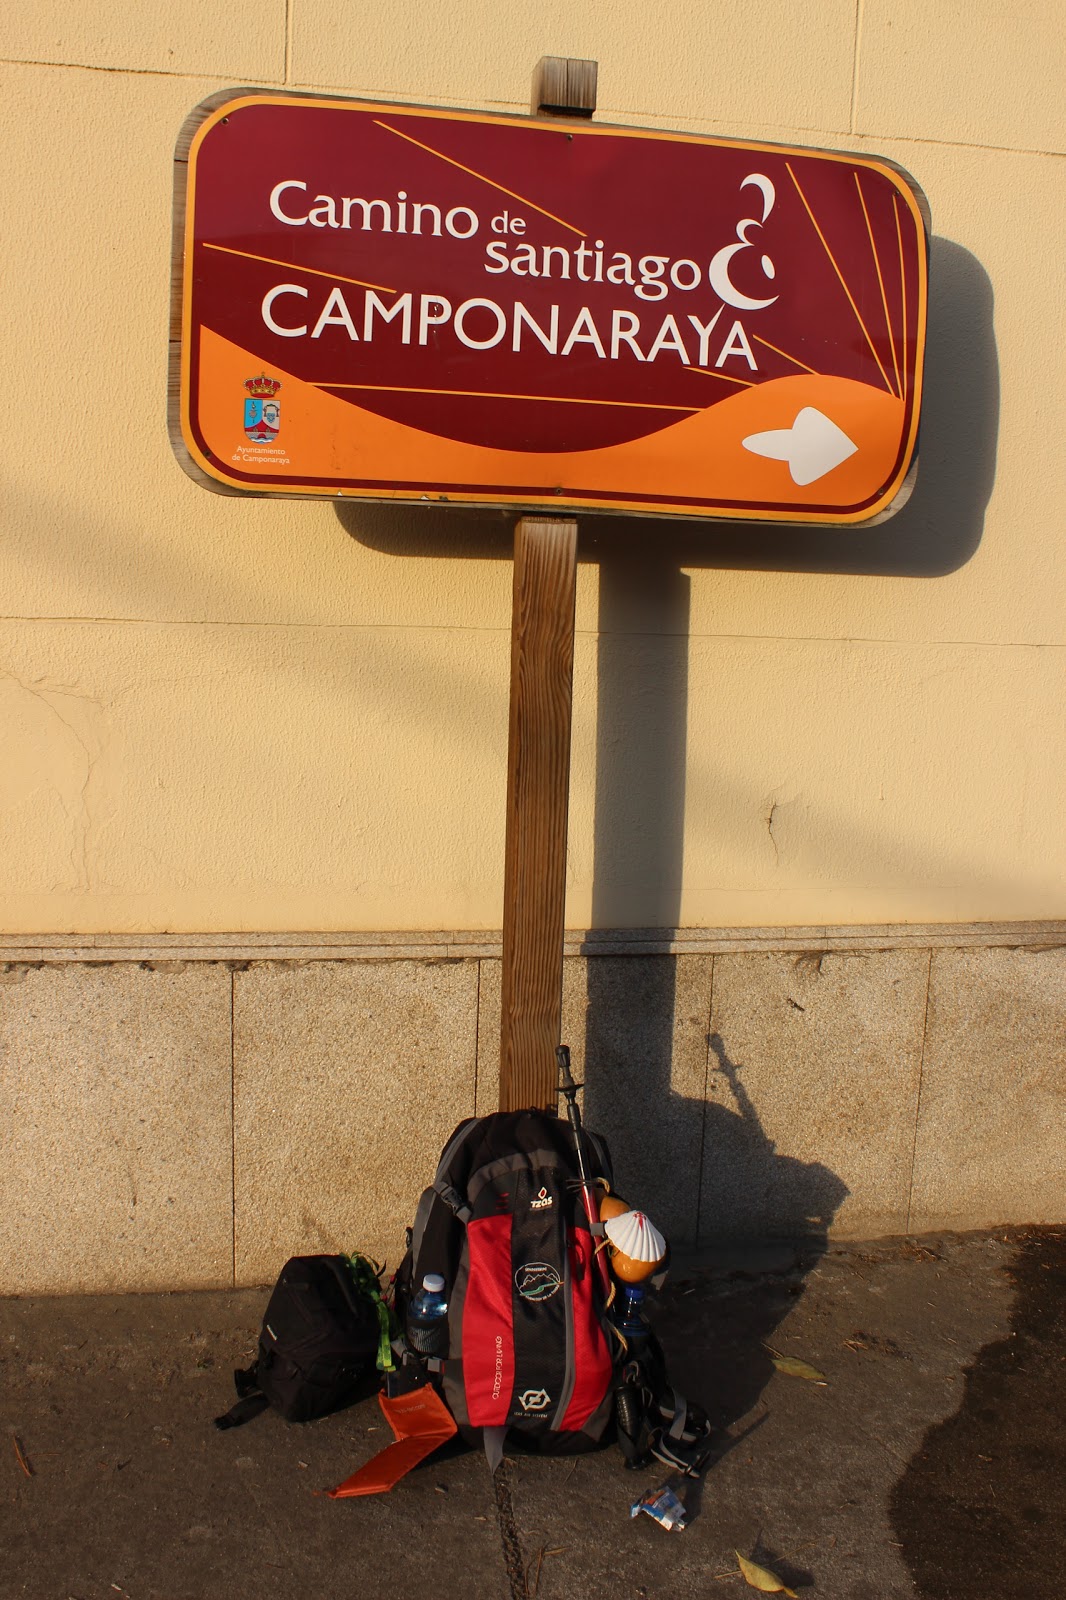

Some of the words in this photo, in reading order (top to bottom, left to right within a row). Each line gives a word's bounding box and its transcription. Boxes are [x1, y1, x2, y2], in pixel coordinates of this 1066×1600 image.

[269, 180, 479, 239] Camino
[490, 210, 527, 236] de
[484, 240, 702, 302] santiago
[261, 284, 759, 371] CAMPONARAYA
[237, 446, 286, 455] Ayuntamiento
[242, 454, 290, 465] Camponaraya
